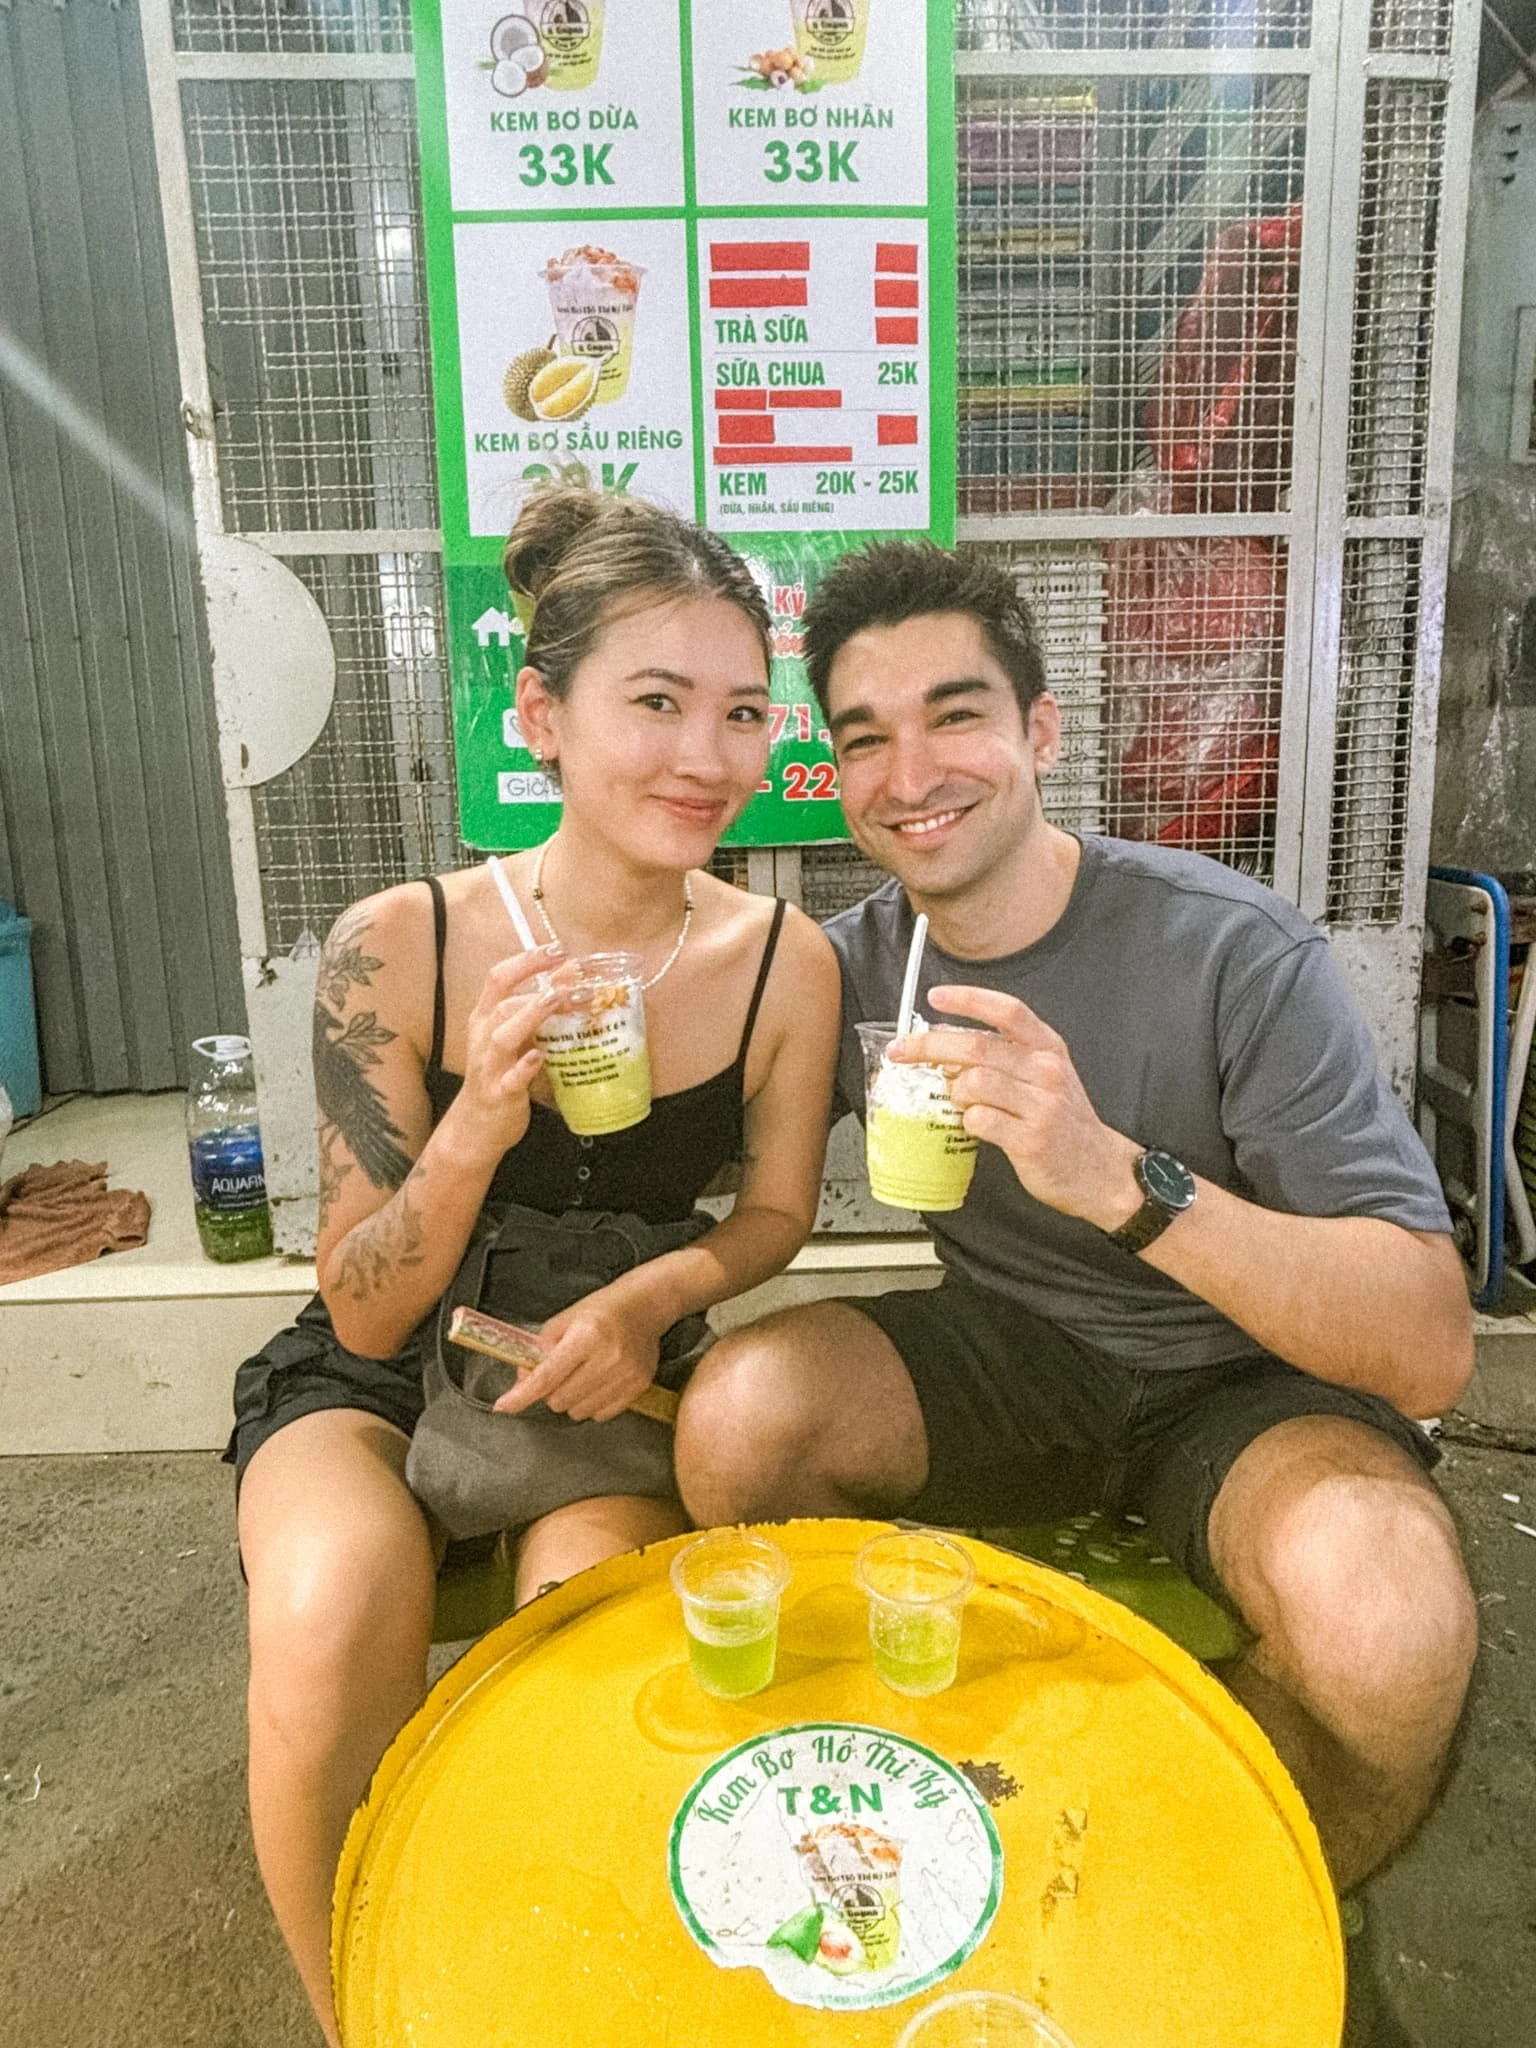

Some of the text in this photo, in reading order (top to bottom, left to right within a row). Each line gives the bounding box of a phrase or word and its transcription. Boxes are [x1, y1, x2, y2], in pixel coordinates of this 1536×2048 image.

[490, 104, 639, 132] KEM BƠ DỪA
[729, 107, 776, 128] KEM
[785, 104, 818, 128] BƠ
[519, 143, 616, 187] 33K
[763, 139, 860, 183] 33K
[714, 313, 808, 344] TRÀ SỮA
[716, 357, 918, 386] SỮA CHUA 25K
[474, 432, 519, 452] KEM
[528, 428, 559, 451] BƠ
[617, 425, 683, 450] RIÊNG
[719, 472, 767, 496] KEM
[816, 471, 856, 494] 20K
[878, 470, 918, 494] 25K
[697, 1773, 757, 1825] Kem
[752, 1749, 796, 1779] Bơ
[778, 1783, 884, 1817] T&N
